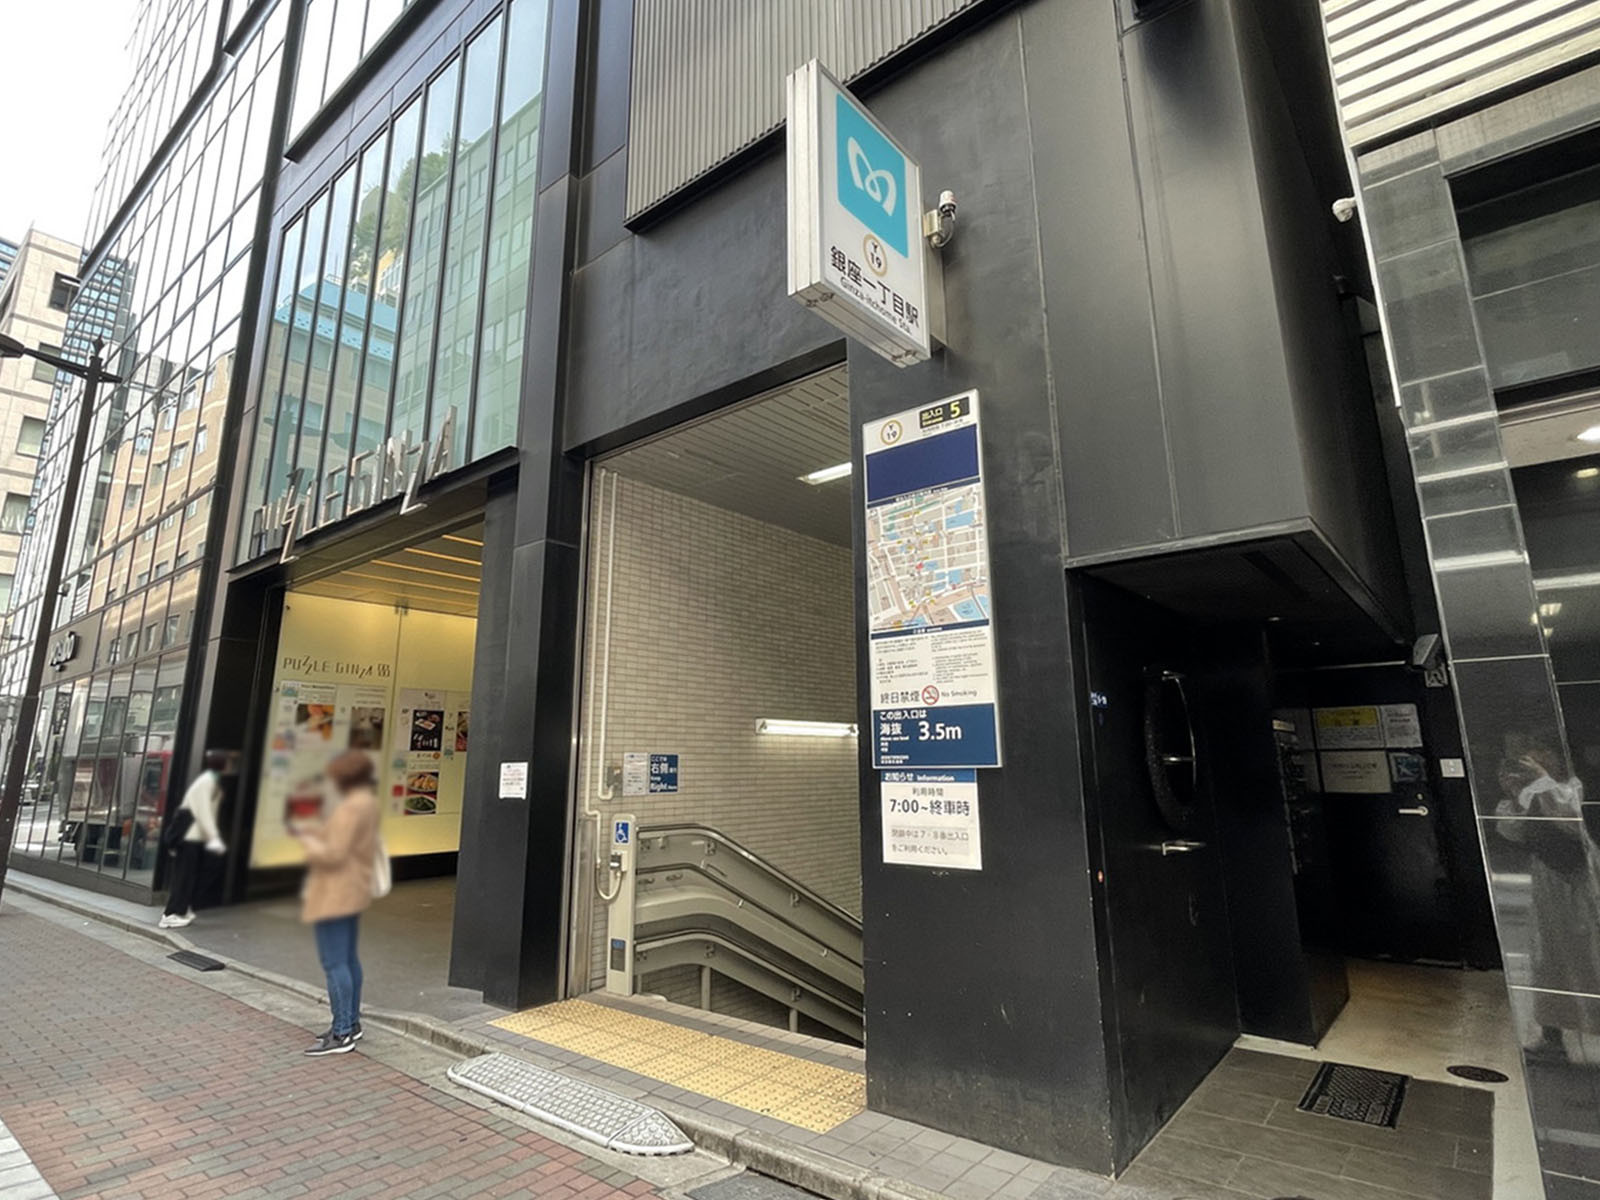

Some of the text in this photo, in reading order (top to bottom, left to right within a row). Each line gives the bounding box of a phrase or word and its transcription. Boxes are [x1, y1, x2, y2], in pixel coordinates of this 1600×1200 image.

[870, 252, 882, 269] 19
[830, 245, 919, 328] 銀座一丁目駅
[950, 400, 961, 418] 5
[282, 655, 374, 679] PUZZLE GINZA
[951, 689, 978, 697] Smoking
[879, 709, 927, 720] この出入口は
[918, 720, 962, 741] 3.5m
